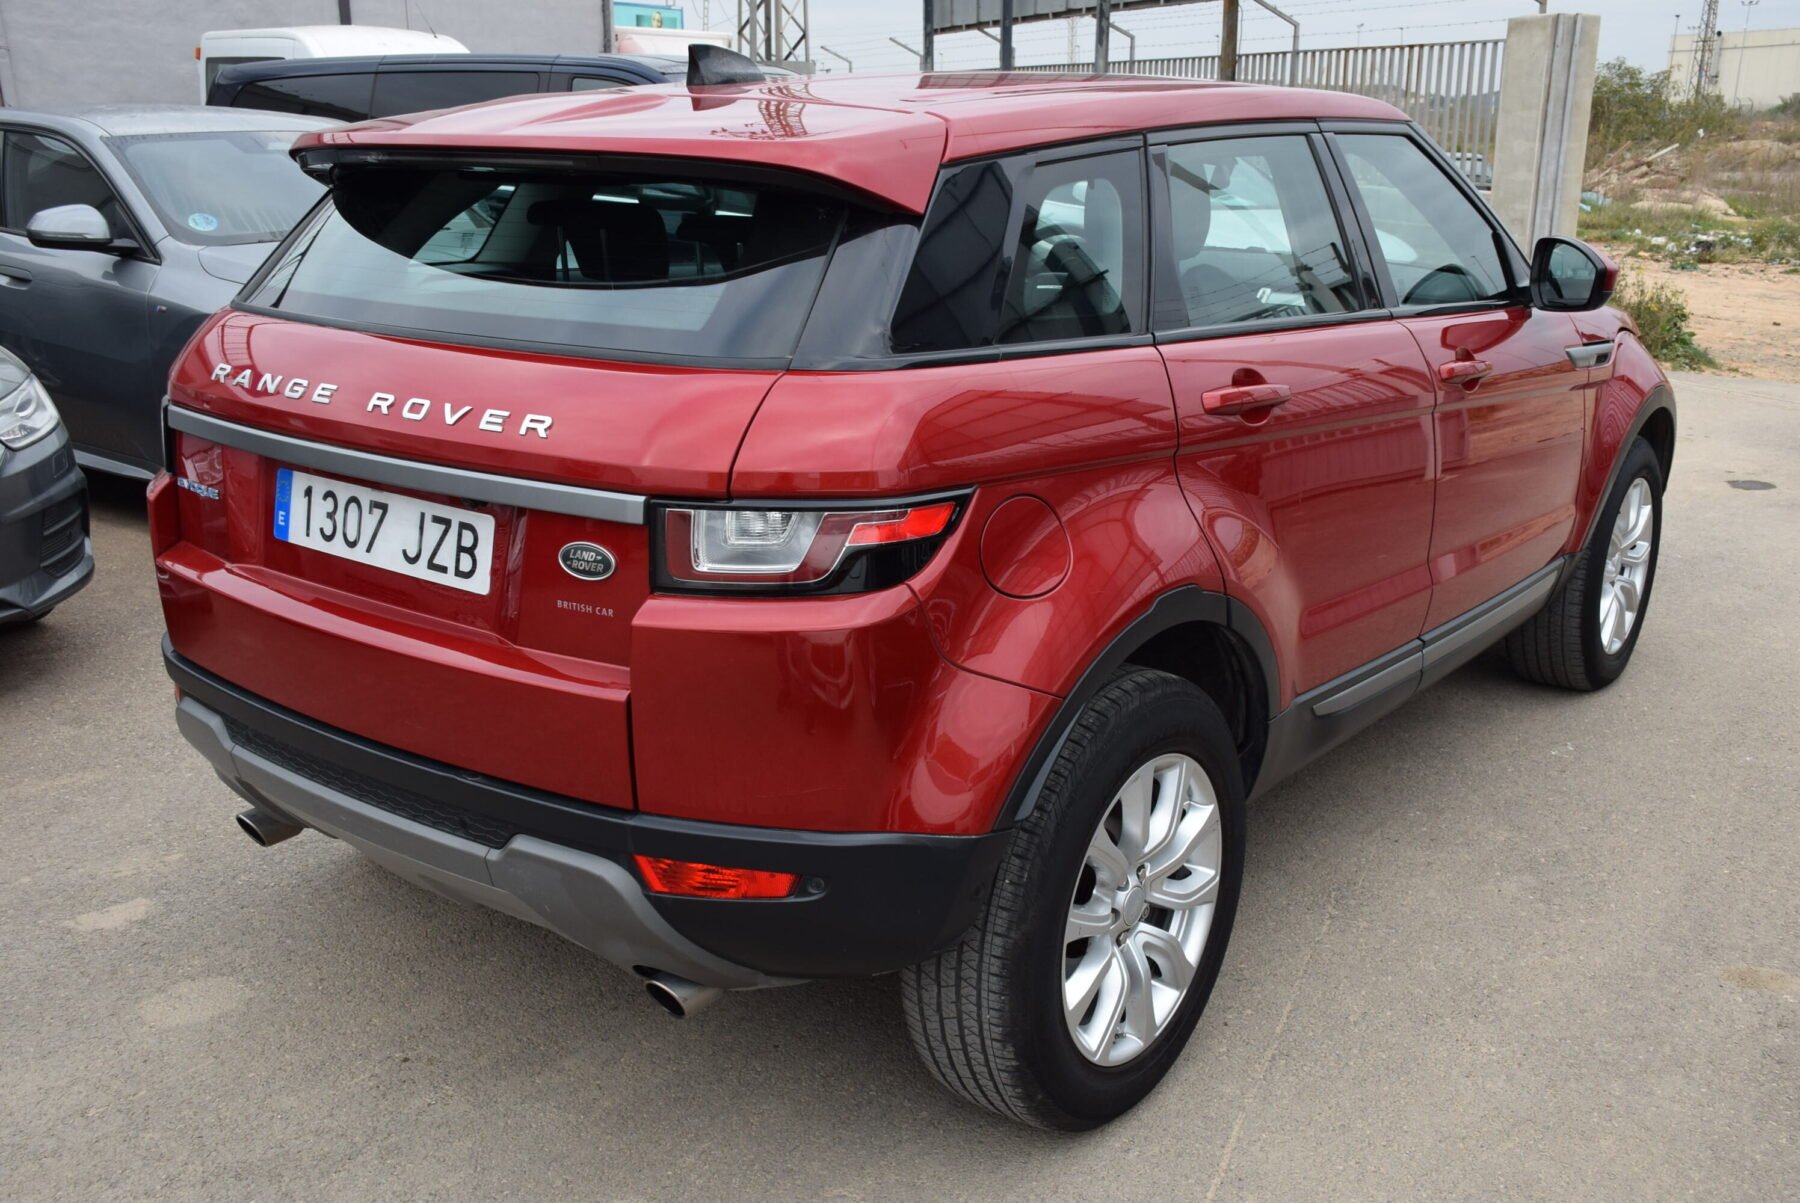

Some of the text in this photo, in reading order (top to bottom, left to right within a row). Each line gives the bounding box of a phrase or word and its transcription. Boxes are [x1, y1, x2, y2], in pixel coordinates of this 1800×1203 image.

[211, 363, 553, 438] RANGE ROVER
[278, 510, 286, 526] E
[303, 485, 479, 580] 1307 JZB
[557, 600, 614, 617] BRITISH CAR
